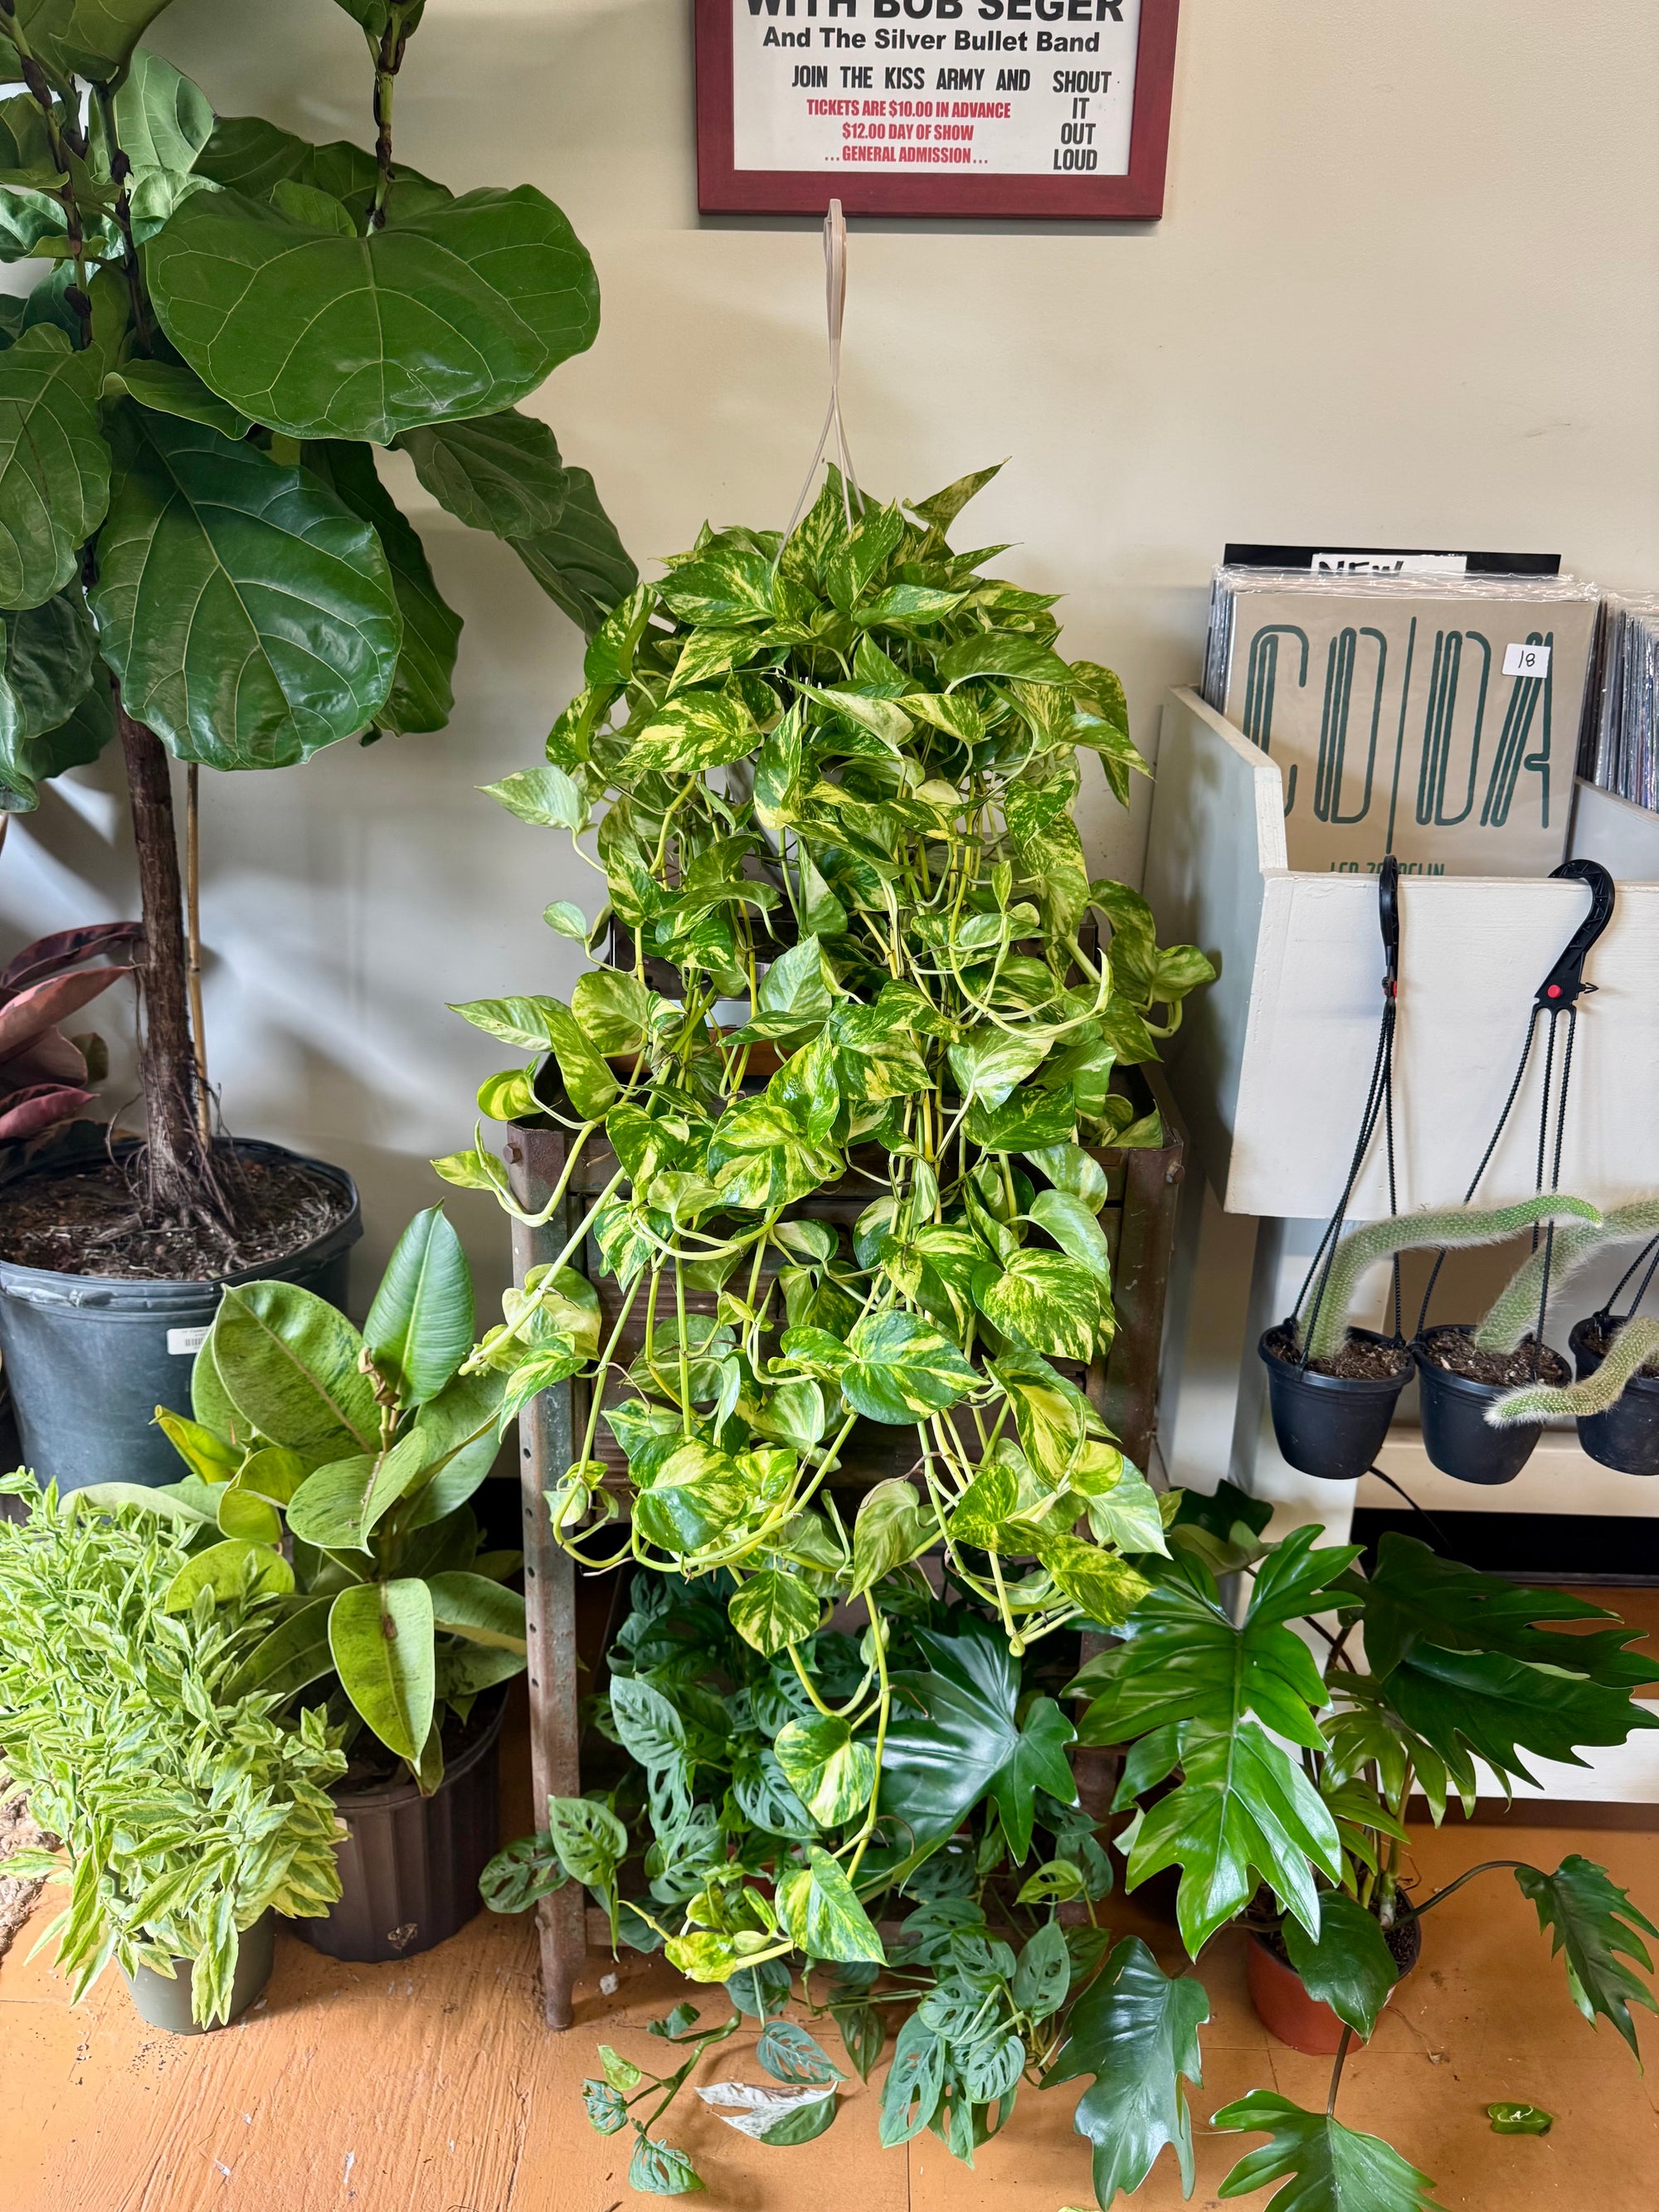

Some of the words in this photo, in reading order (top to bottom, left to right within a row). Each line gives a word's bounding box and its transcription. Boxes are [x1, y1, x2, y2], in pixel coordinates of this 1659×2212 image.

[747, 0, 857, 17] WITH
[873, 0, 963, 20] BOB
[977, 0, 1124, 22] SEGER
[762, 26, 811, 48] And
[819, 27, 867, 50] The
[874, 28, 947, 51] Silver
[954, 30, 1029, 52] Bullet
[1036, 32, 1100, 53] Band
[791, 65, 828, 89] JOIN
[839, 66, 873, 90] THE
[884, 67, 926, 90] KISS
[936, 68, 985, 91] ARMY
[995, 69, 1031, 91] AND
[1052, 70, 1112, 94] SHOUT
[806, 99, 860, 117] TICKETS
[862, 100, 886, 118] ARE
[888, 100, 933, 119] $10.00
[935, 101, 950, 119] IN
[951, 101, 1011, 119] ADVANCE
[1072, 97, 1090, 119] IT
[842, 122, 886, 141] $12.00
[888, 123, 914, 141] DAY
[916, 124, 932, 142] OF
[934, 124, 975, 142] SHOW
[1060, 122, 1097, 146] OUT
[1053, 148, 1098, 172] LOUD
[1517, 649, 1536, 668] 18
